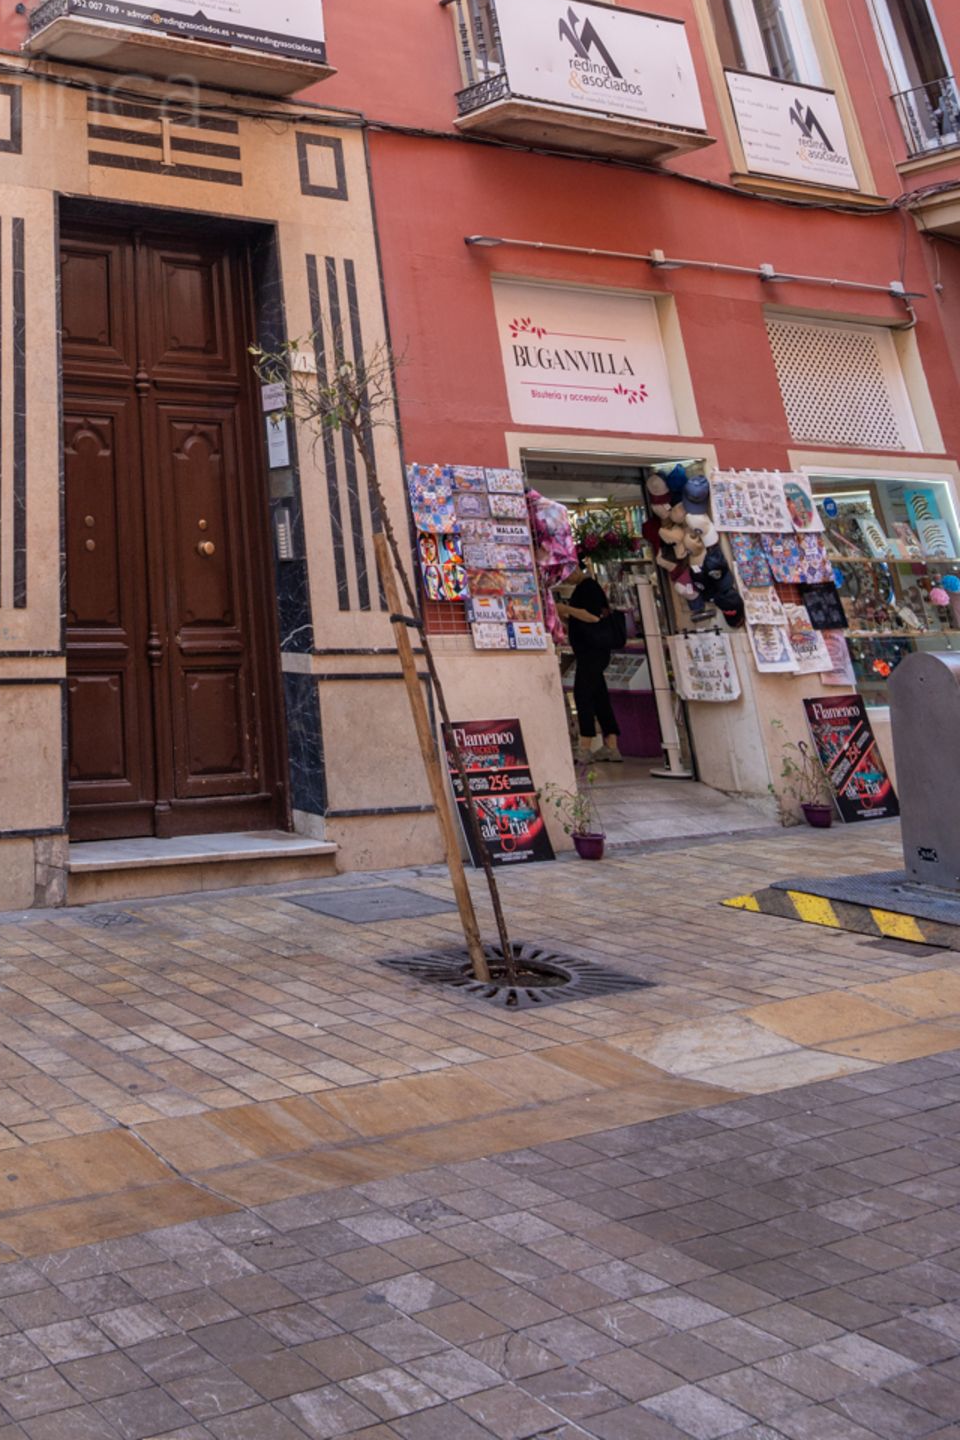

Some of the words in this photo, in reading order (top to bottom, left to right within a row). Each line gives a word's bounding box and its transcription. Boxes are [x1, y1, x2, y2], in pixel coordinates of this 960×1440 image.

[88, 0, 103, 11] 007
[569, 58, 610, 80] reding
[581, 73, 643, 96] asociados
[512, 344, 636, 377] BUGANVILLA
[812, 703, 860, 720] Flamenco
[452, 728, 515, 748] Flamenco
[489, 774, 511, 791] 25€
